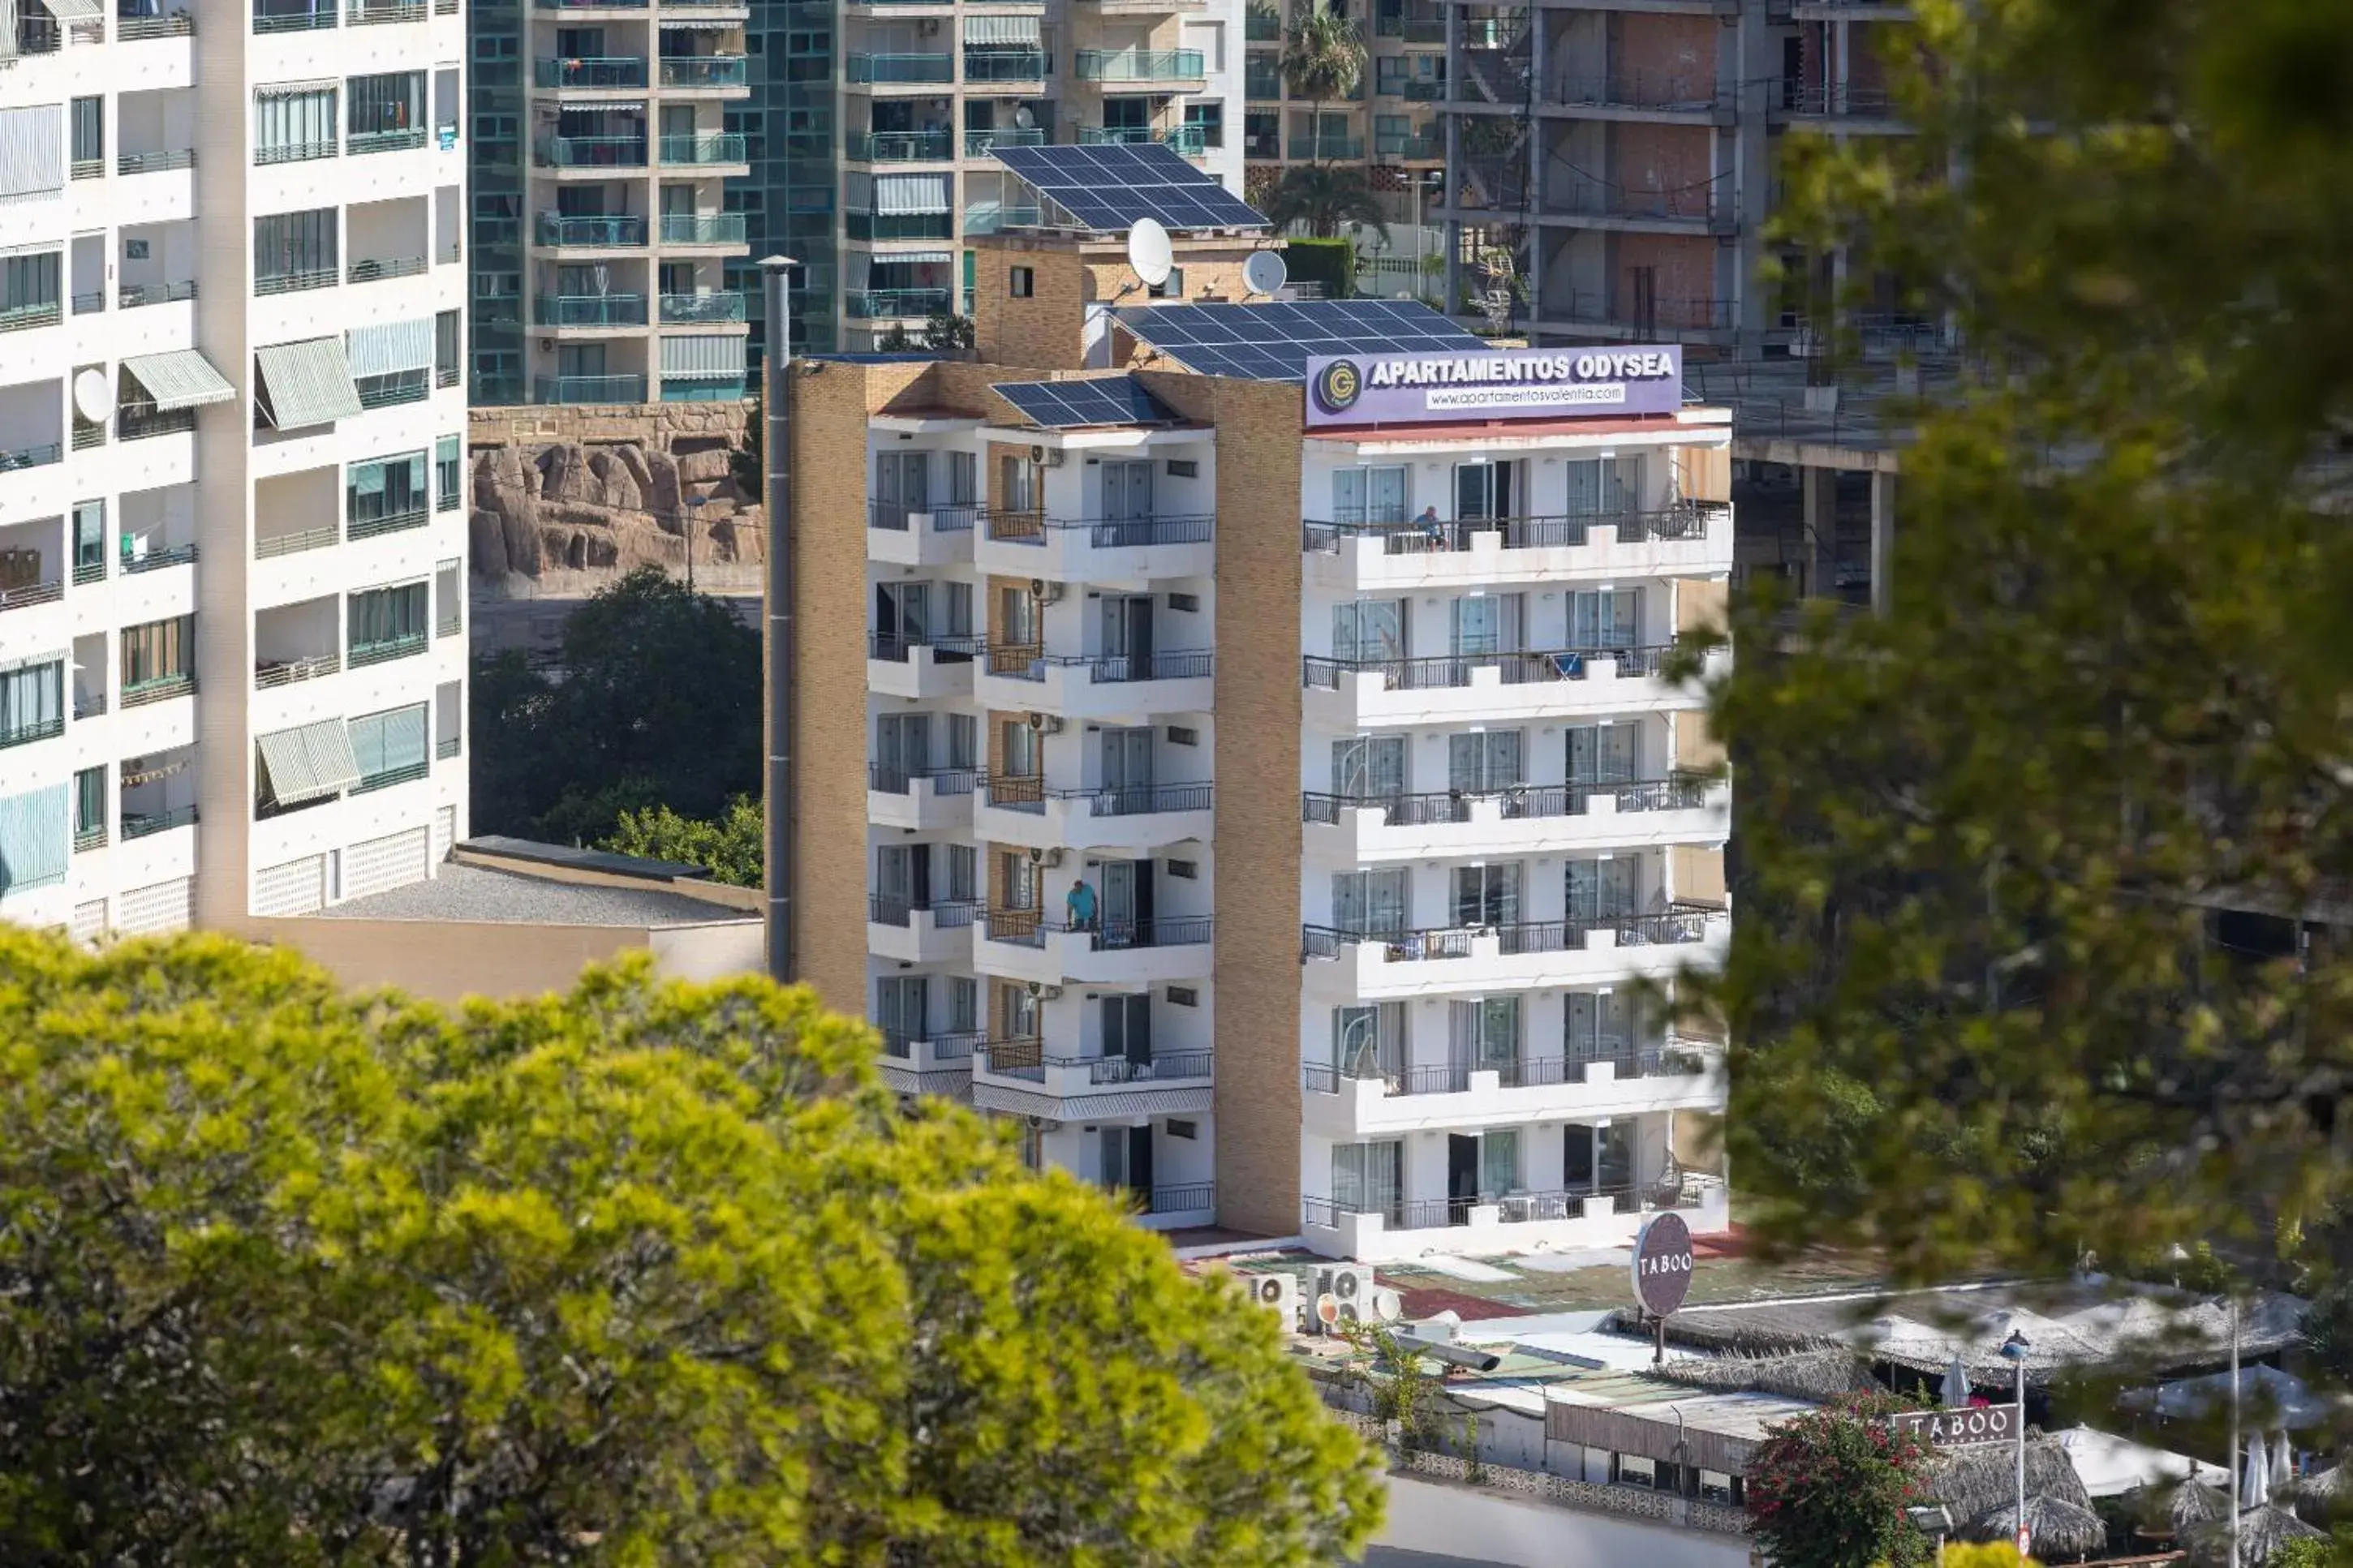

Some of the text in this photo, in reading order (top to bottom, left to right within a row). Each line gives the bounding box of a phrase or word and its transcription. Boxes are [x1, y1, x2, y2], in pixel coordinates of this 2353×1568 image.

[1370, 353, 1675, 385] APARTAMENTOS ODYSEA
[1641, 1253, 1692, 1275] TABOO
[1910, 1411, 2007, 1437] TABOO
